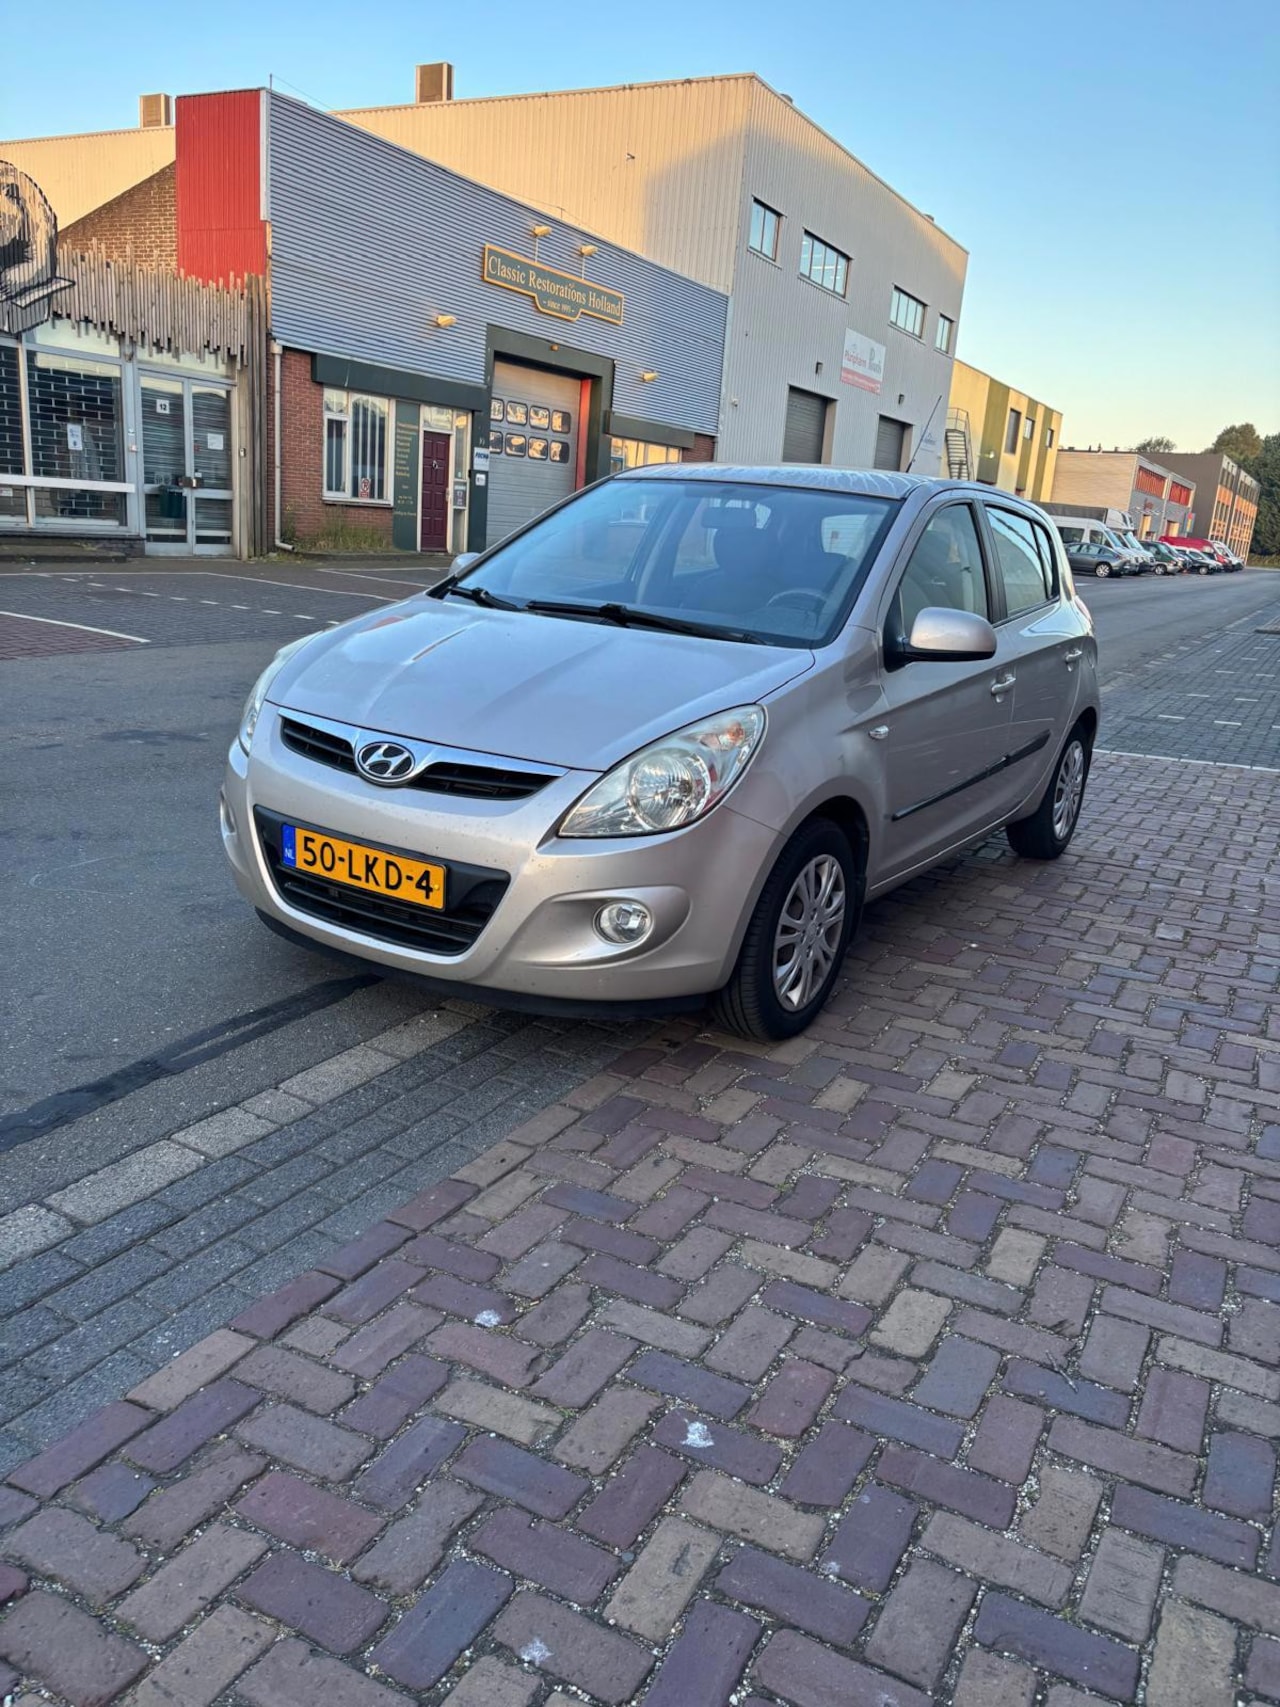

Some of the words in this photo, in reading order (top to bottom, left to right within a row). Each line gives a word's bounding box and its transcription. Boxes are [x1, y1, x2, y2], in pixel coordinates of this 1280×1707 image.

[488, 255, 526, 285] Classic
[528, 269, 586, 305] Restorations
[588, 291, 621, 317] Holland
[159, 403, 167, 411] 12
[284, 846, 295, 860] NL
[302, 835, 434, 900] 50-LKD-4
